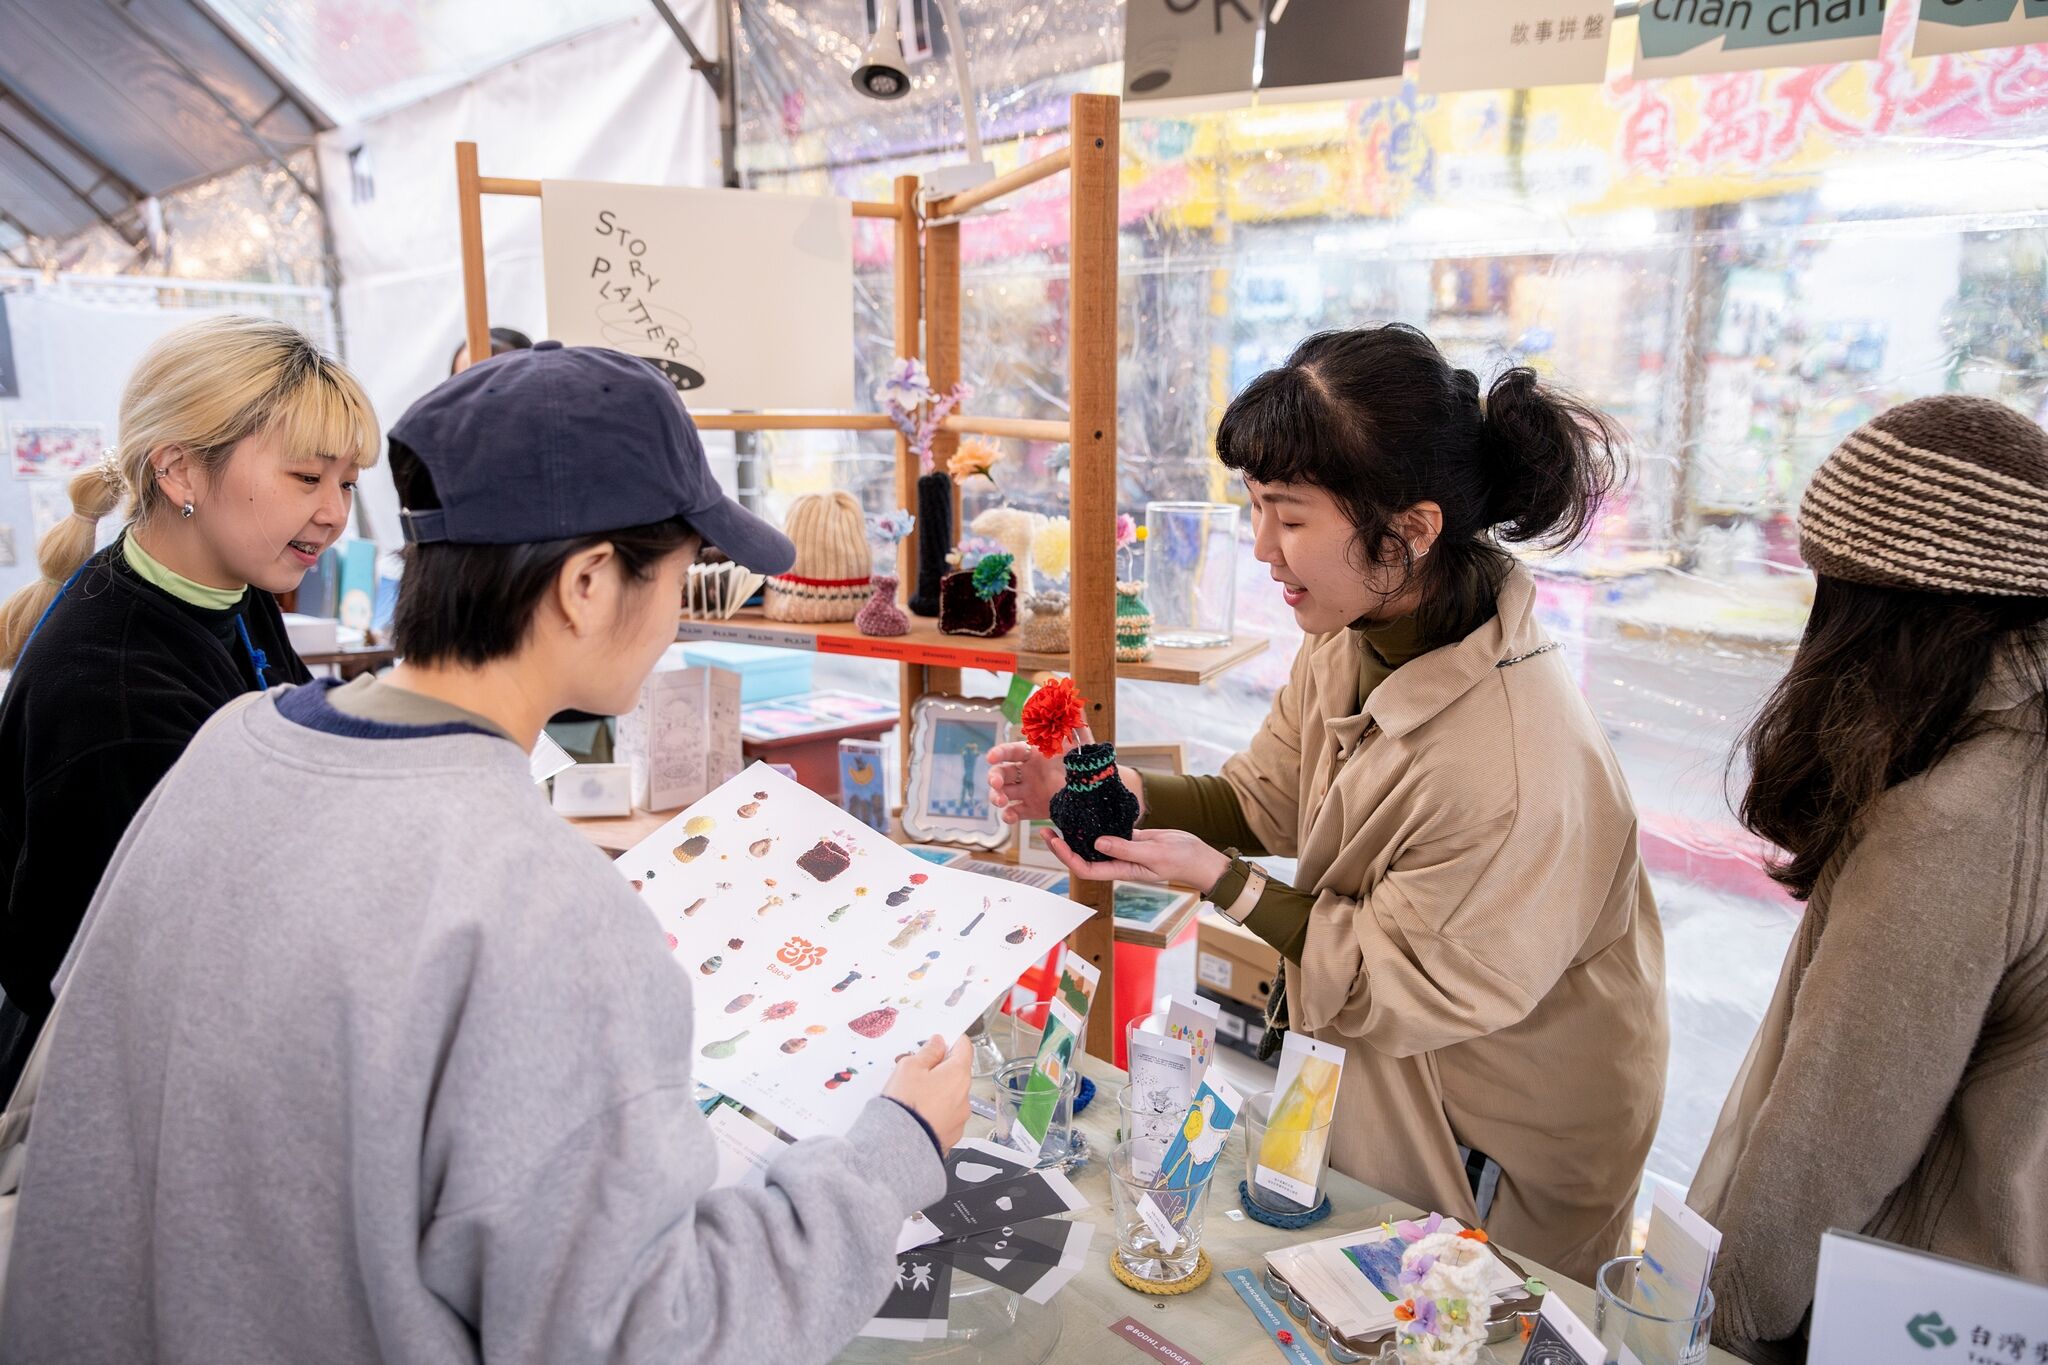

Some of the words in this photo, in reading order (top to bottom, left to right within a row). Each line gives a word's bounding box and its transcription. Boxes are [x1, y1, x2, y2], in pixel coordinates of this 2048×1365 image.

[1510, 13, 1604, 47] 故事拼盤
[1652, 0, 1752, 30] chan
[594, 210, 660, 292] STORY
[591, 256, 680, 357] PLATTER
